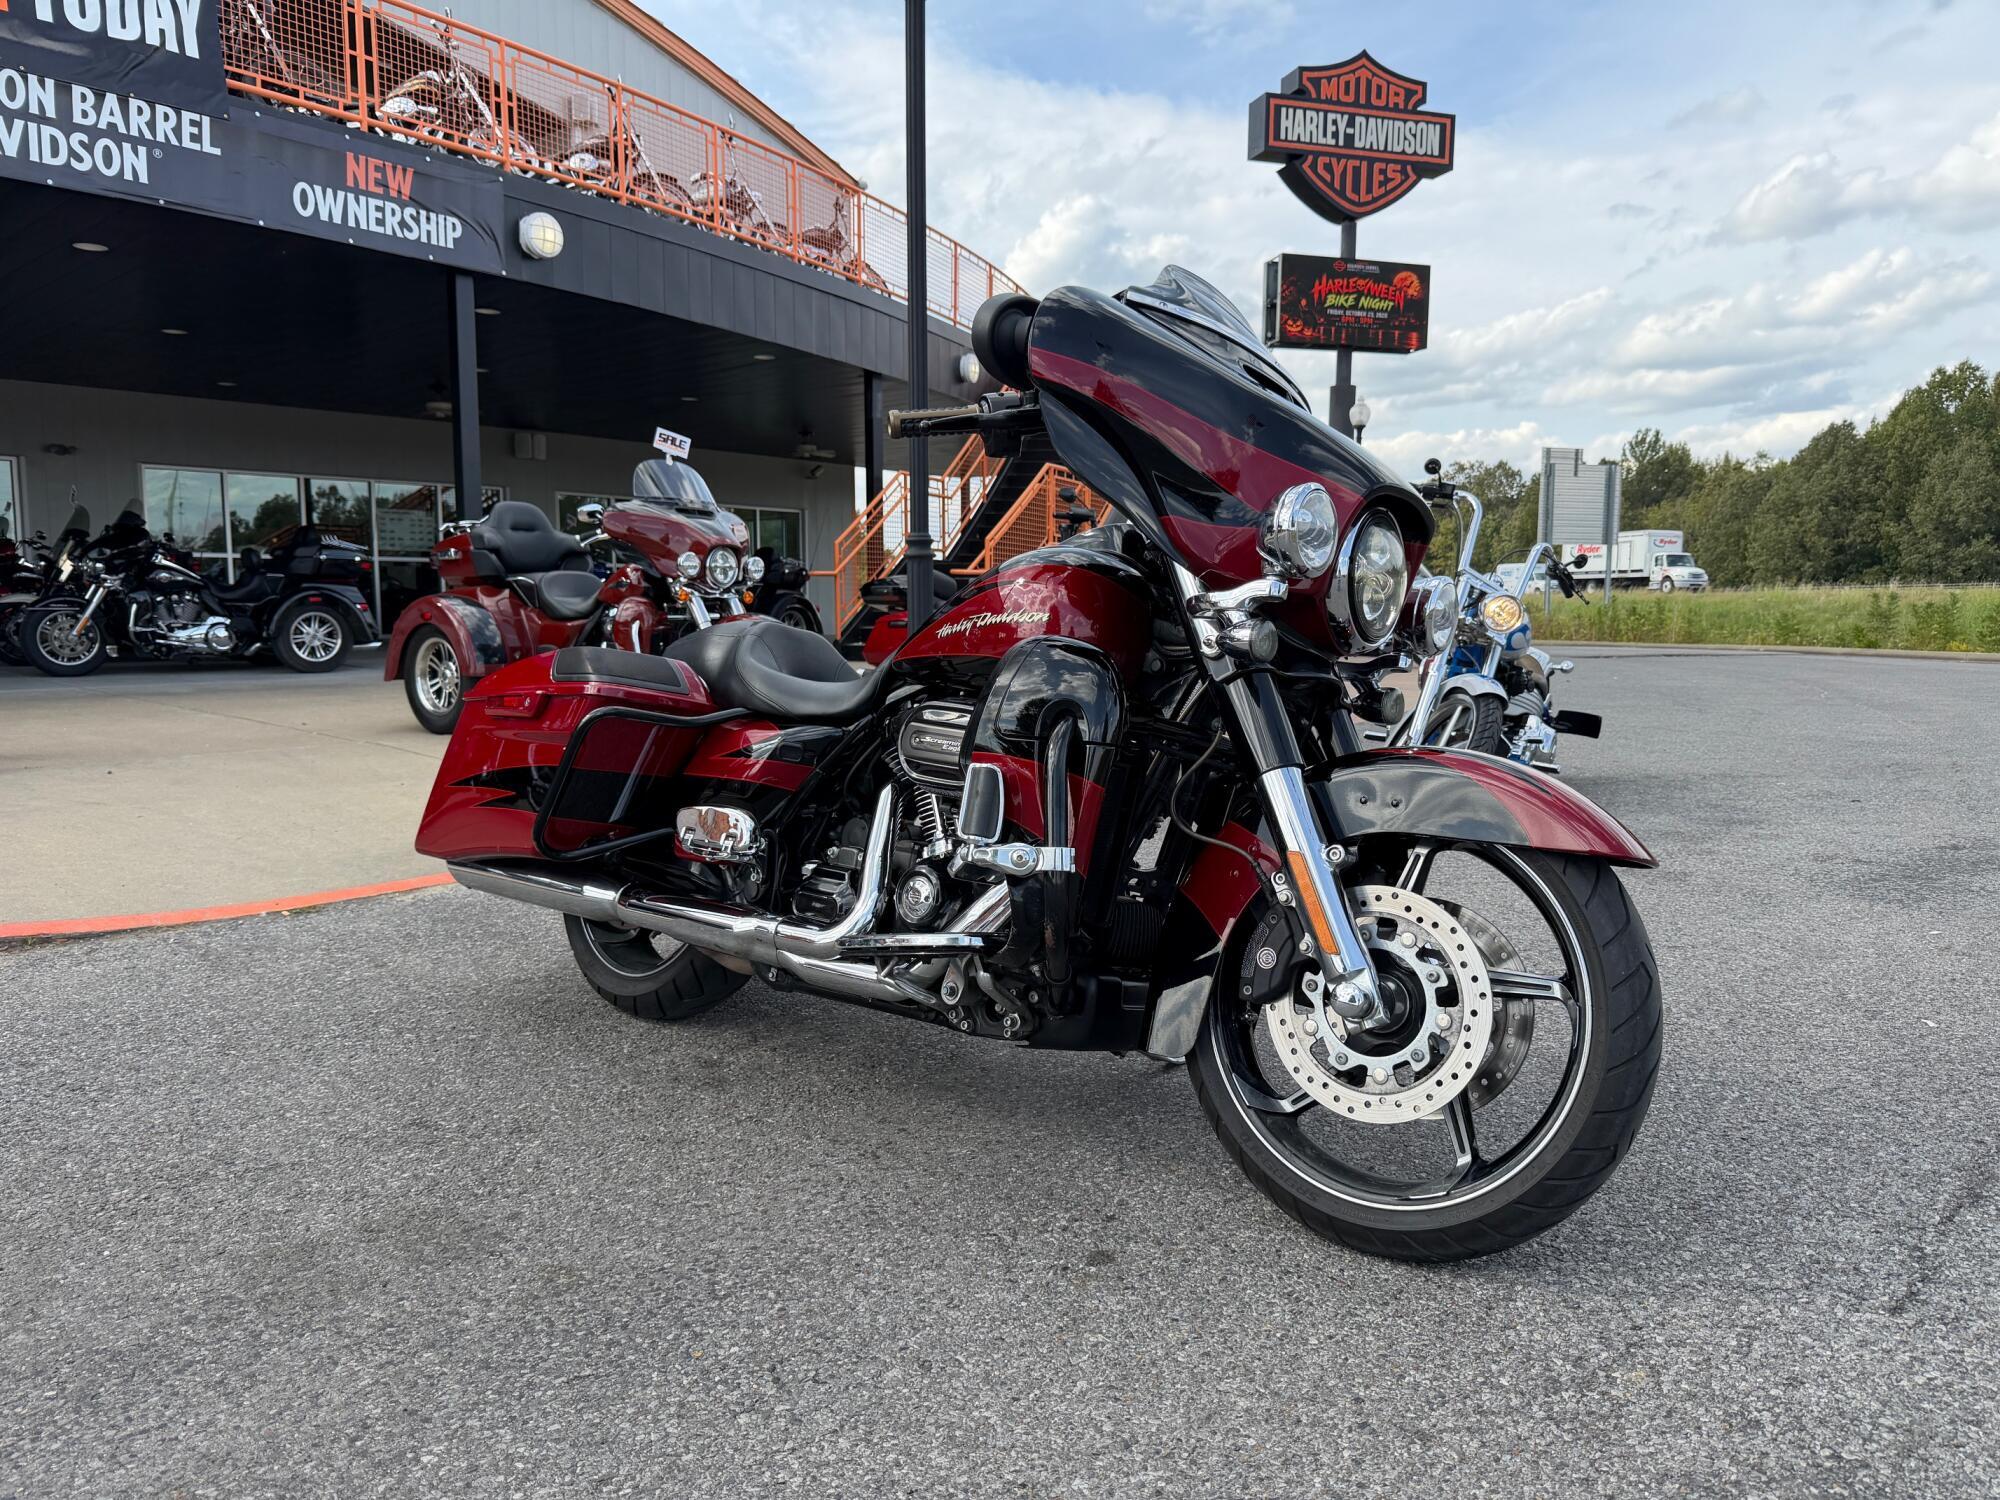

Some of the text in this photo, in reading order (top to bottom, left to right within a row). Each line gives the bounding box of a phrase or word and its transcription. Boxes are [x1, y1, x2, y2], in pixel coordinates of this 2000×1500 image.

[1320, 67, 1405, 110] MOTOR
[72, 83, 222, 156] BARREL
[1280, 107, 1441, 156] HARLEY-DAVIDSON
[346, 152, 414, 200] NEW
[1317, 156, 1402, 203] CYCLES
[292, 181, 462, 249] OWNERSHIP
[1324, 293, 1394, 312] BIKE NIGHT
[658, 432, 687, 450] SALE
[1576, 543, 1601, 555] Ryder
